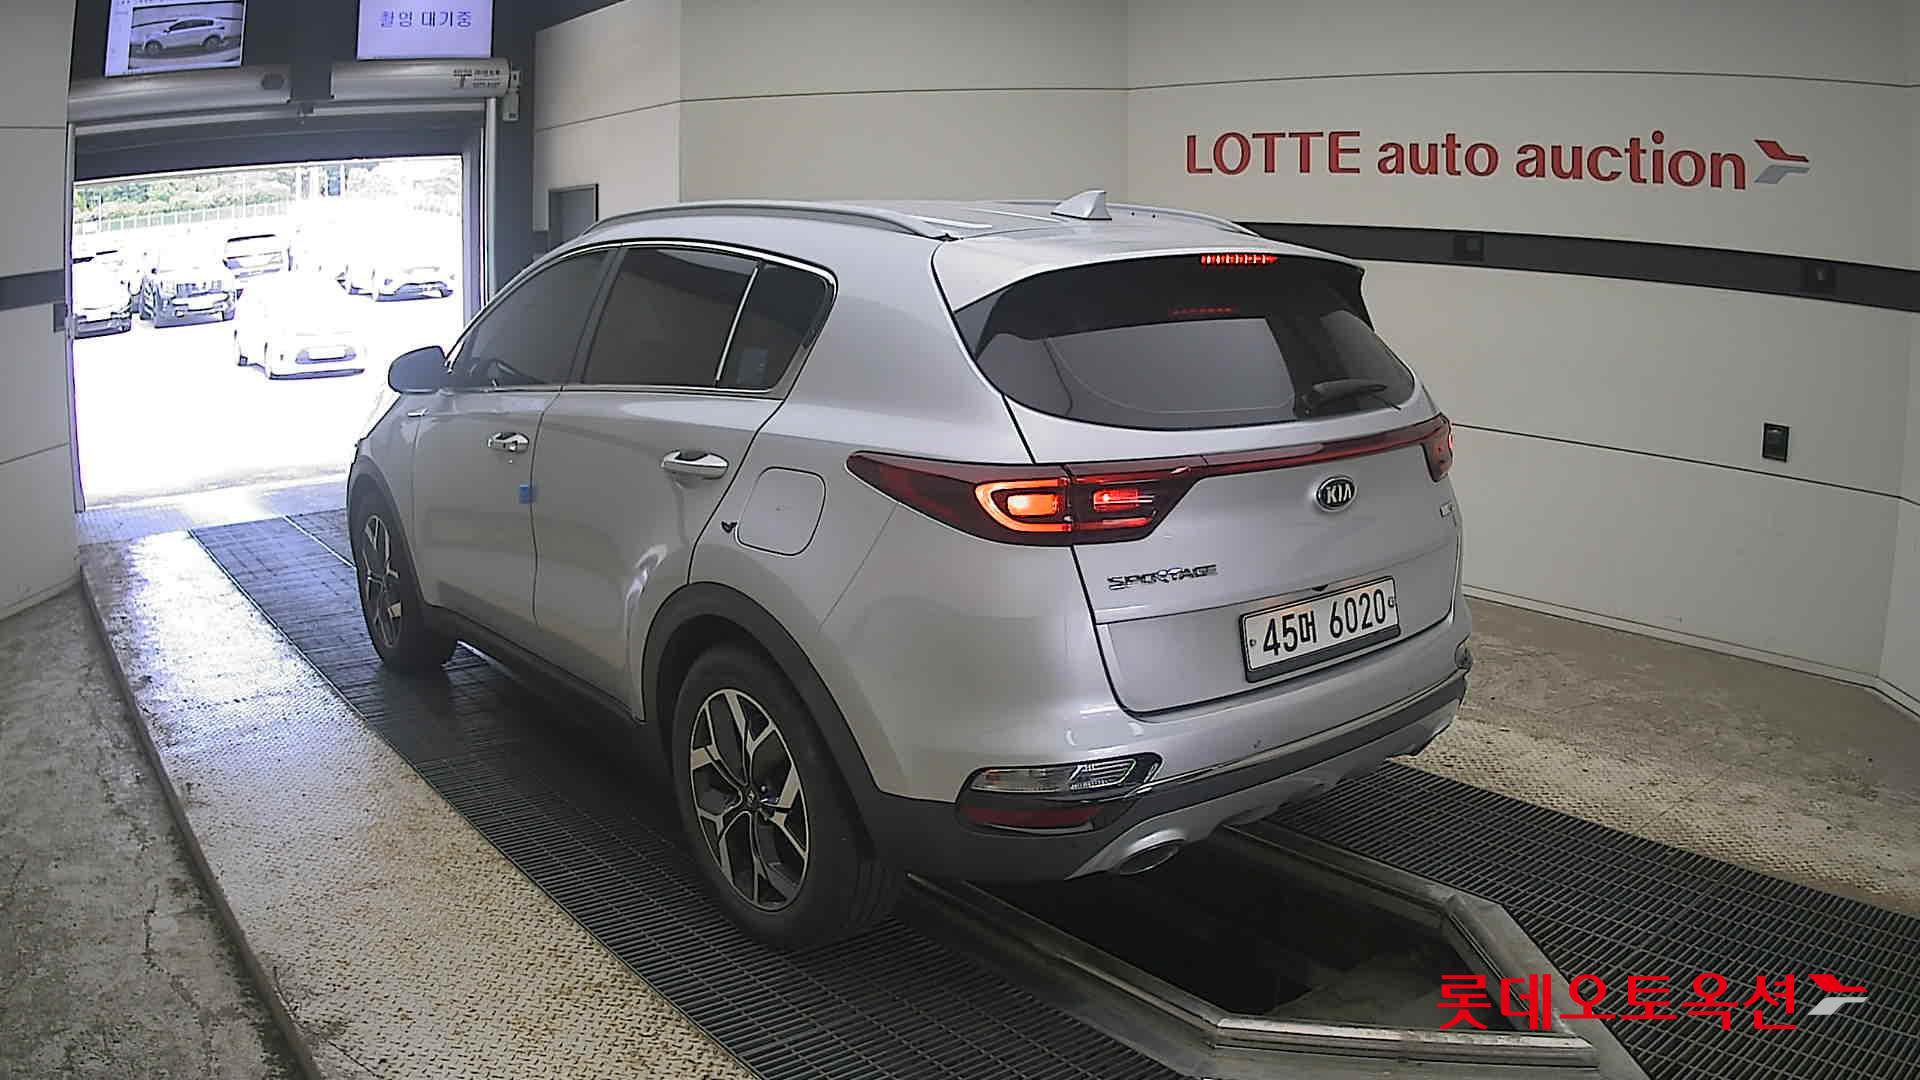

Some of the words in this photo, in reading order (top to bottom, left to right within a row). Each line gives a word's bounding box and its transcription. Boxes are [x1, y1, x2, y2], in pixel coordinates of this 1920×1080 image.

[421, 10, 472, 28] 대기중
[1186, 131, 1361, 175] LOTTE
[1378, 133, 1500, 177] auto
[1517, 131, 1745, 189] auction
[1325, 483, 1352, 505] KIA
[1263, 610, 1317, 656] 45머
[1329, 588, 1386, 639] 6020
